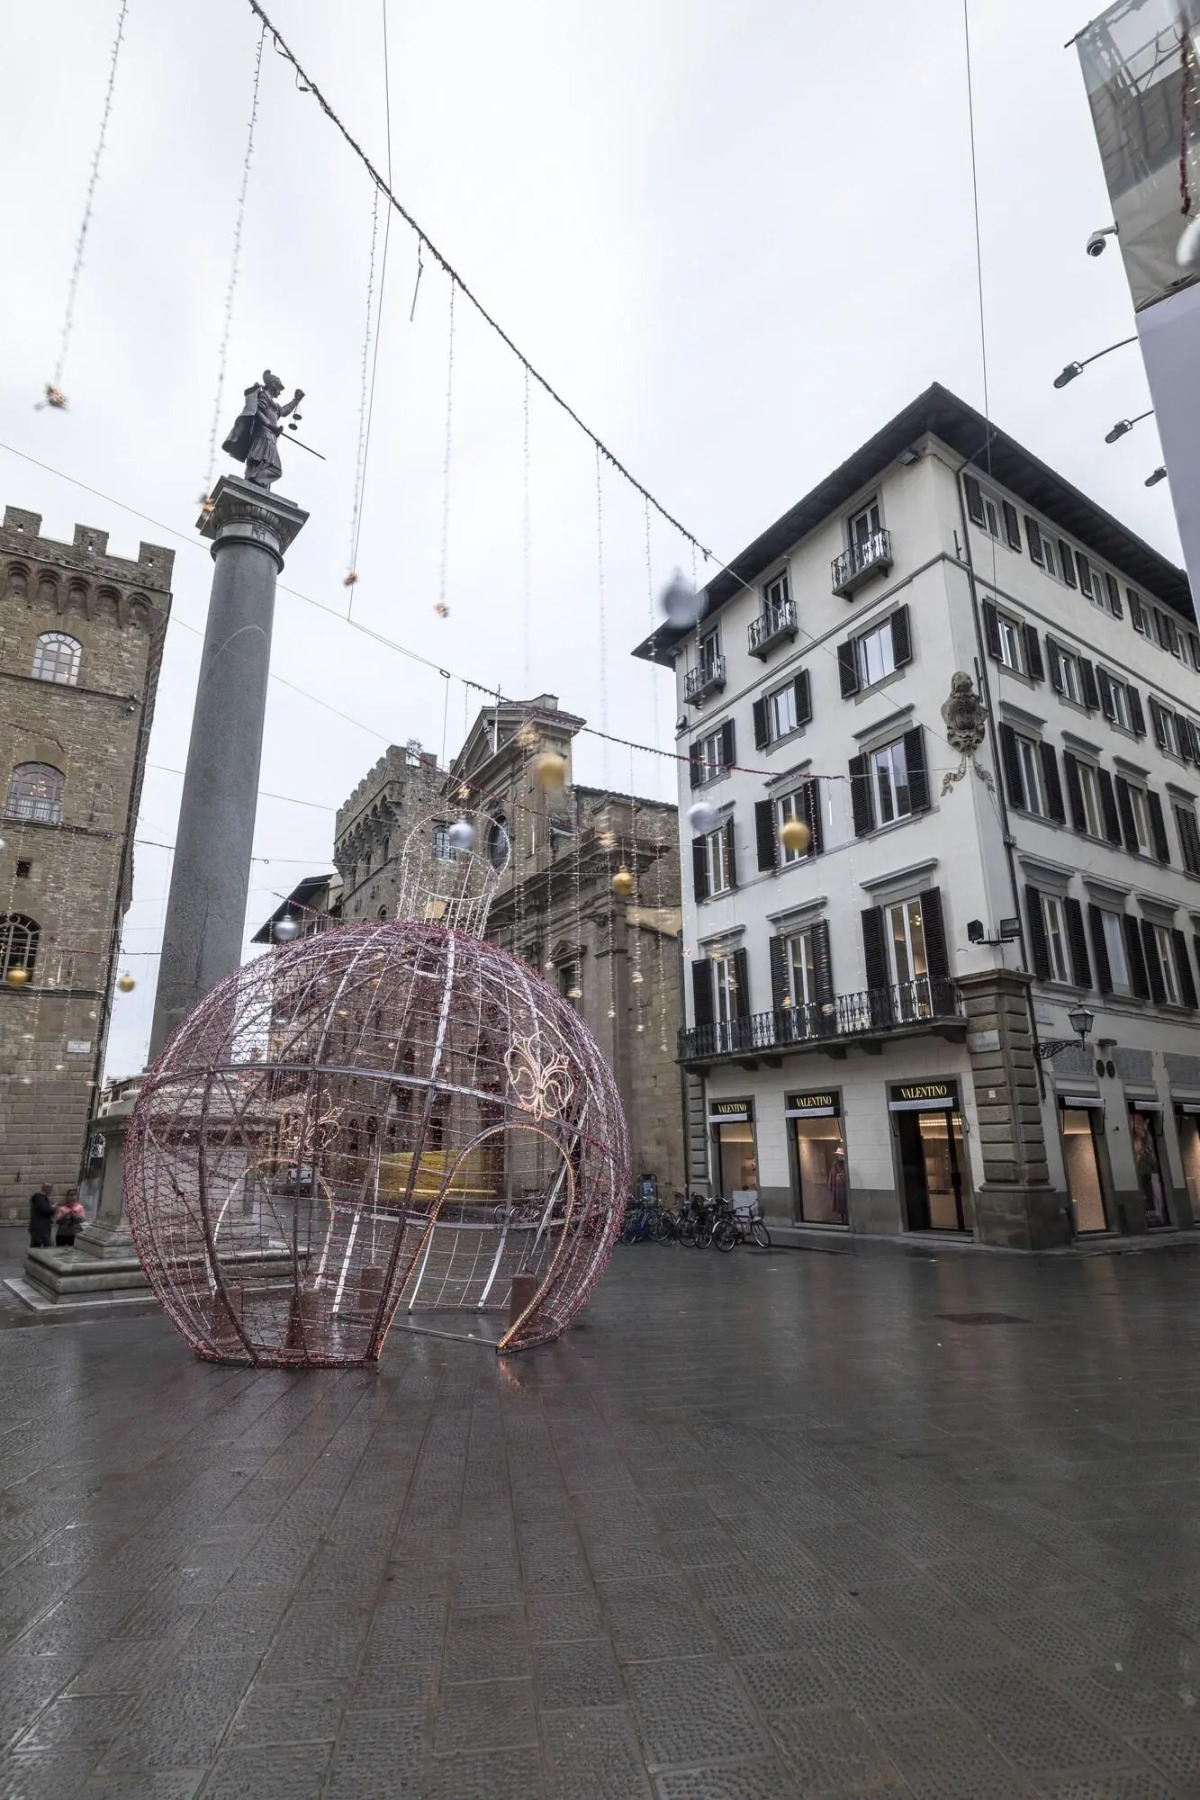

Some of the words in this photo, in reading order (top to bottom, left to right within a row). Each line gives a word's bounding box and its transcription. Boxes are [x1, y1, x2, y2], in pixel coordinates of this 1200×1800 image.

[901, 1085, 947, 1098] VALENTINO
[796, 1095, 832, 1107] VALENTINO
[718, 1103, 747, 1113] VALENTINO
